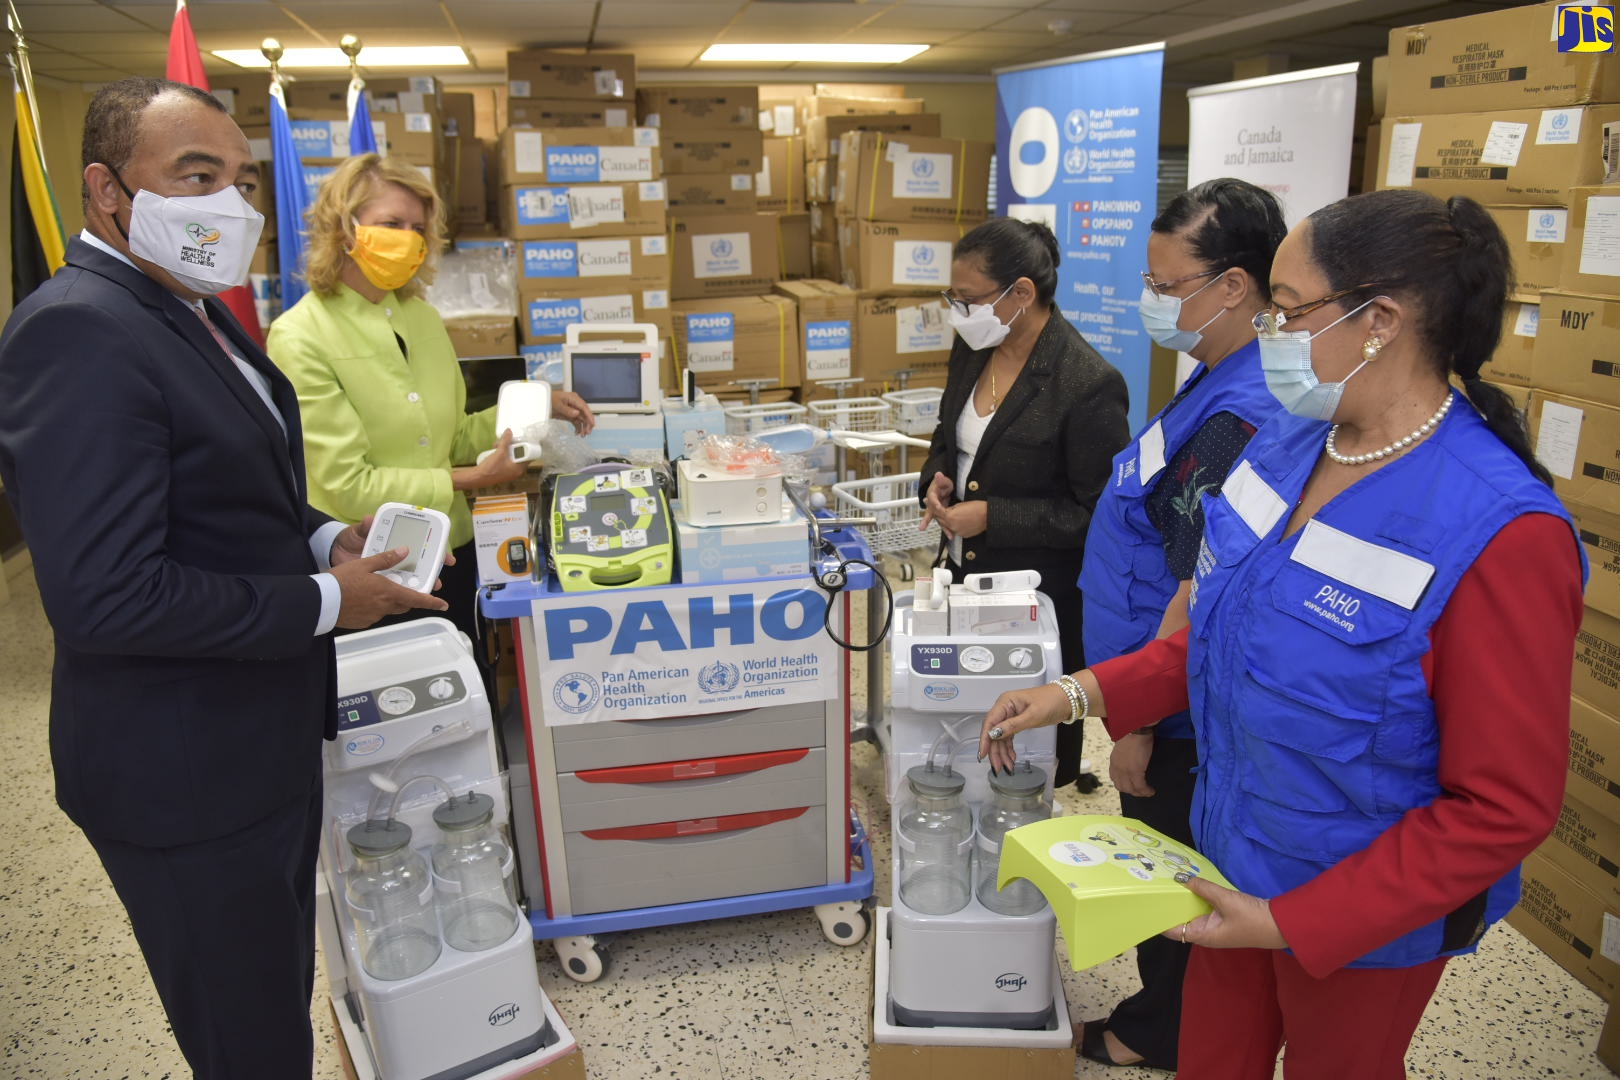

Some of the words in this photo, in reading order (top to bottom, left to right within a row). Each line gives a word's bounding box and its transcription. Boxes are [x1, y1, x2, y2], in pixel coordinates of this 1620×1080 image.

[1466, 42, 1489, 53] MEDICAL
[1452, 52, 1485, 64] RESPIRATOR
[1487, 49, 1504, 60] MASK
[1481, 70, 1508, 82] PRODUCT
[292, 127, 328, 140] AHO
[1237, 125, 1282, 146] Canada
[1451, 139, 1474, 148] MEDICAL
[547, 153, 597, 166] PAHO
[1223, 147, 1245, 166] and
[1247, 146, 1295, 167] Jamaica
[1437, 148, 1469, 157] RESPIRATOR
[1471, 147, 1484, 157] MAS
[601, 158, 649, 172] Canada
[1429, 167, 1463, 179] NON-STERILE
[1464, 168, 1489, 179] PRODUCT
[1092, 200, 1141, 213] PAHOWHO
[181, 250, 206, 260] HEALTH
[182, 245, 207, 255] MINISTRY
[526, 248, 574, 261] PAHO
[180, 255, 215, 268] WELLNESS
[580, 252, 629, 266] Canada
[531, 305, 579, 320] PAHO
[583, 309, 631, 322] Canada
[1560, 309, 1589, 331] MDY
[689, 316, 731, 329] PAHO
[808, 326, 848, 338] PAHO
[689, 351, 732, 364] Canada
[808, 358, 848, 371] Canada
[1314, 585, 1360, 617] PAHO
[1303, 600, 1355, 633] www.paho.org
[544, 589, 827, 661] PAHO
[1577, 631, 1602, 650] PRODUC
[743, 657, 777, 670] World
[781, 653, 818, 667] Health
[601, 671, 624, 683] Pan
[628, 667, 689, 681] American
[743, 667, 818, 684] Organization
[1590, 669, 1618, 690] MEDICAL
[603, 682, 645, 696] Health
[744, 687, 785, 699] Americas
[338, 695, 368, 709] X930D
[604, 692, 687, 710] Organization
[1570, 729, 1589, 746] DICAL
[1585, 747, 1606, 765] MASK
[1577, 764, 1607, 788] PRODUCT
[1563, 804, 1581, 820] DICAL
[1577, 822, 1597, 840] MASK
[1569, 838, 1599, 864] PRODUCT
[1530, 878, 1557, 900] MEDICAL
[1521, 879, 1553, 907] ESPIRATOR
[1552, 902, 1572, 920] MASK
[1520, 899, 1544, 920] STERILE
[1544, 918, 1572, 944] PRODUCT
